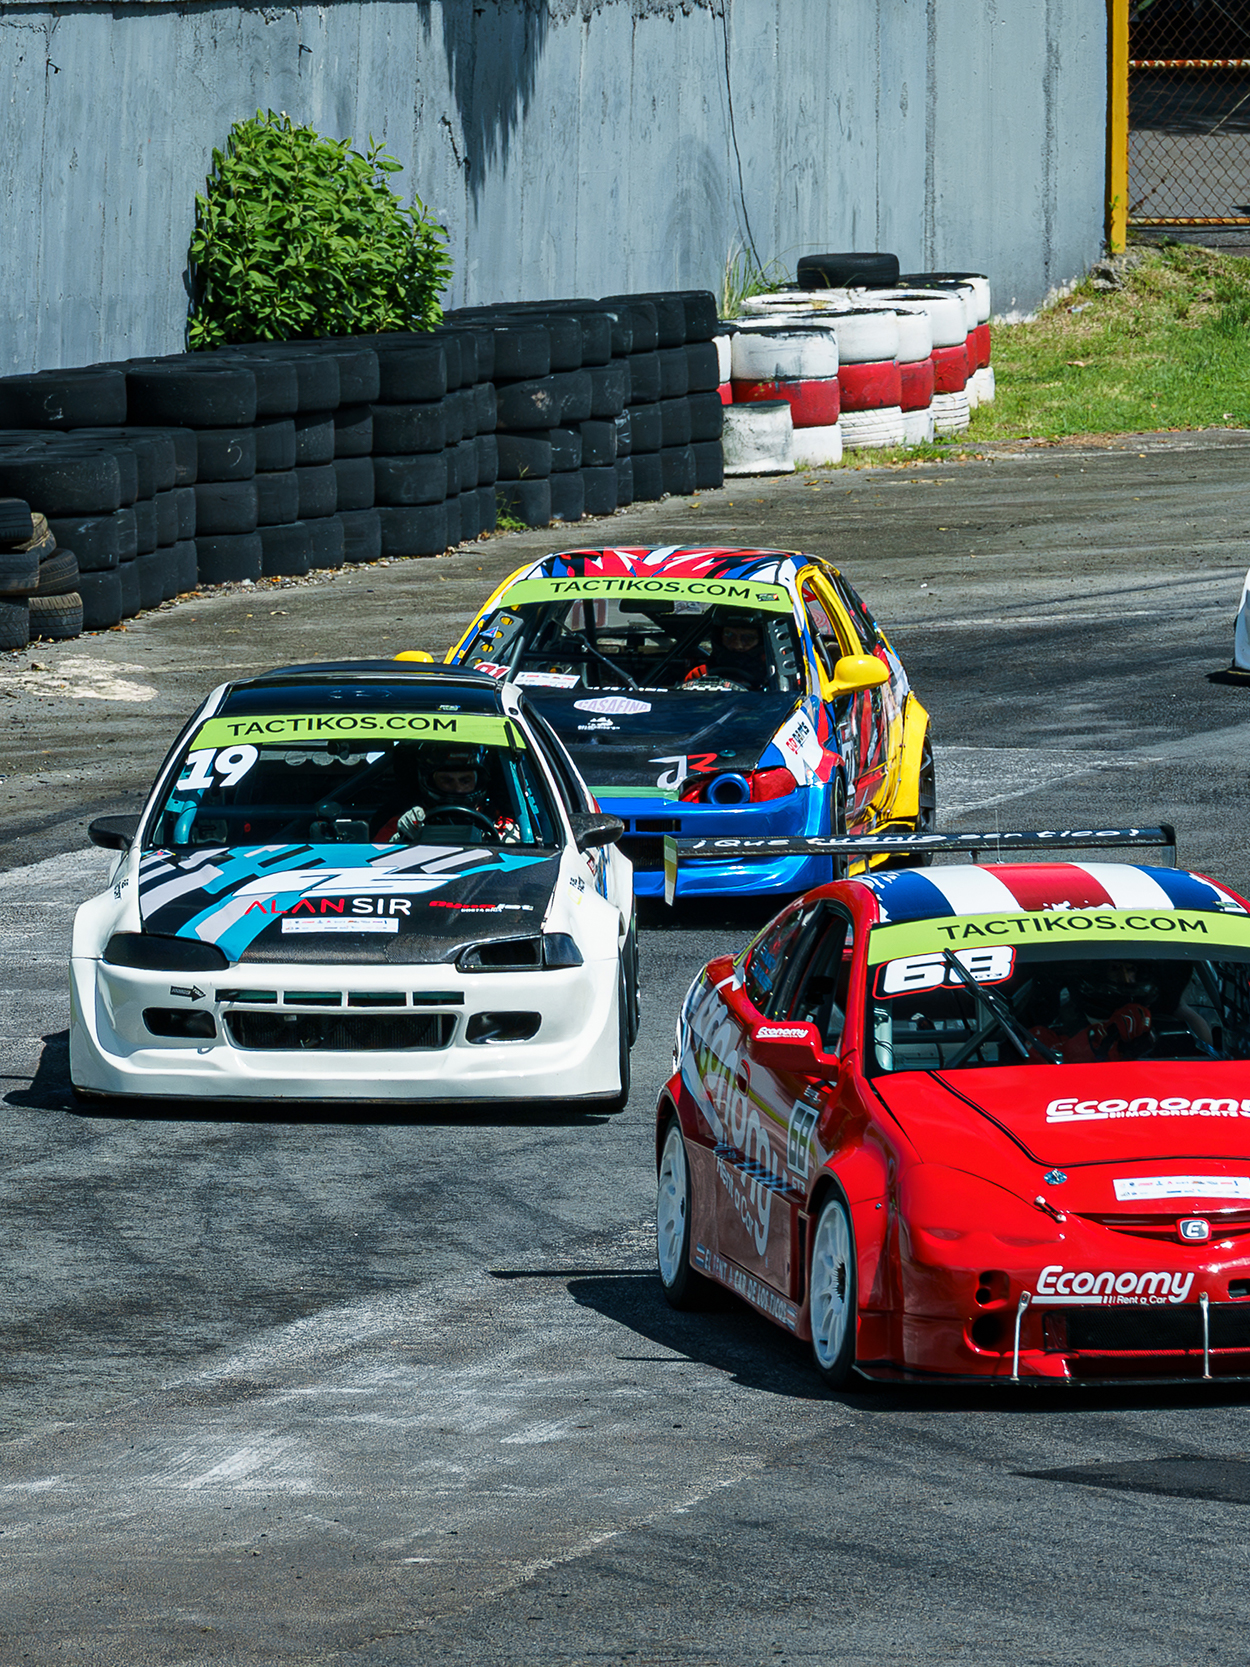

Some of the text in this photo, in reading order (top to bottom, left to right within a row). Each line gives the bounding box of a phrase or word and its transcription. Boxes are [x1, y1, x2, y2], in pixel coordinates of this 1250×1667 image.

[549, 579, 751, 599] TACTIKOS.COM
[227, 716, 457, 737] TACTIKOS.COM
[176, 744, 259, 791] 19
[245, 898, 412, 915] ALAN SIR
[937, 915, 1209, 940] TACTIKOS.COM
[883, 945, 1014, 994] 68
[756, 1026, 809, 1039] Economy
[1126, 1110, 1239, 1118] MOTORSPORTS
[1036, 1265, 1195, 1304] Economy
[1117, 1295, 1138, 1304] Rent
[1149, 1295, 1167, 1304] Car
